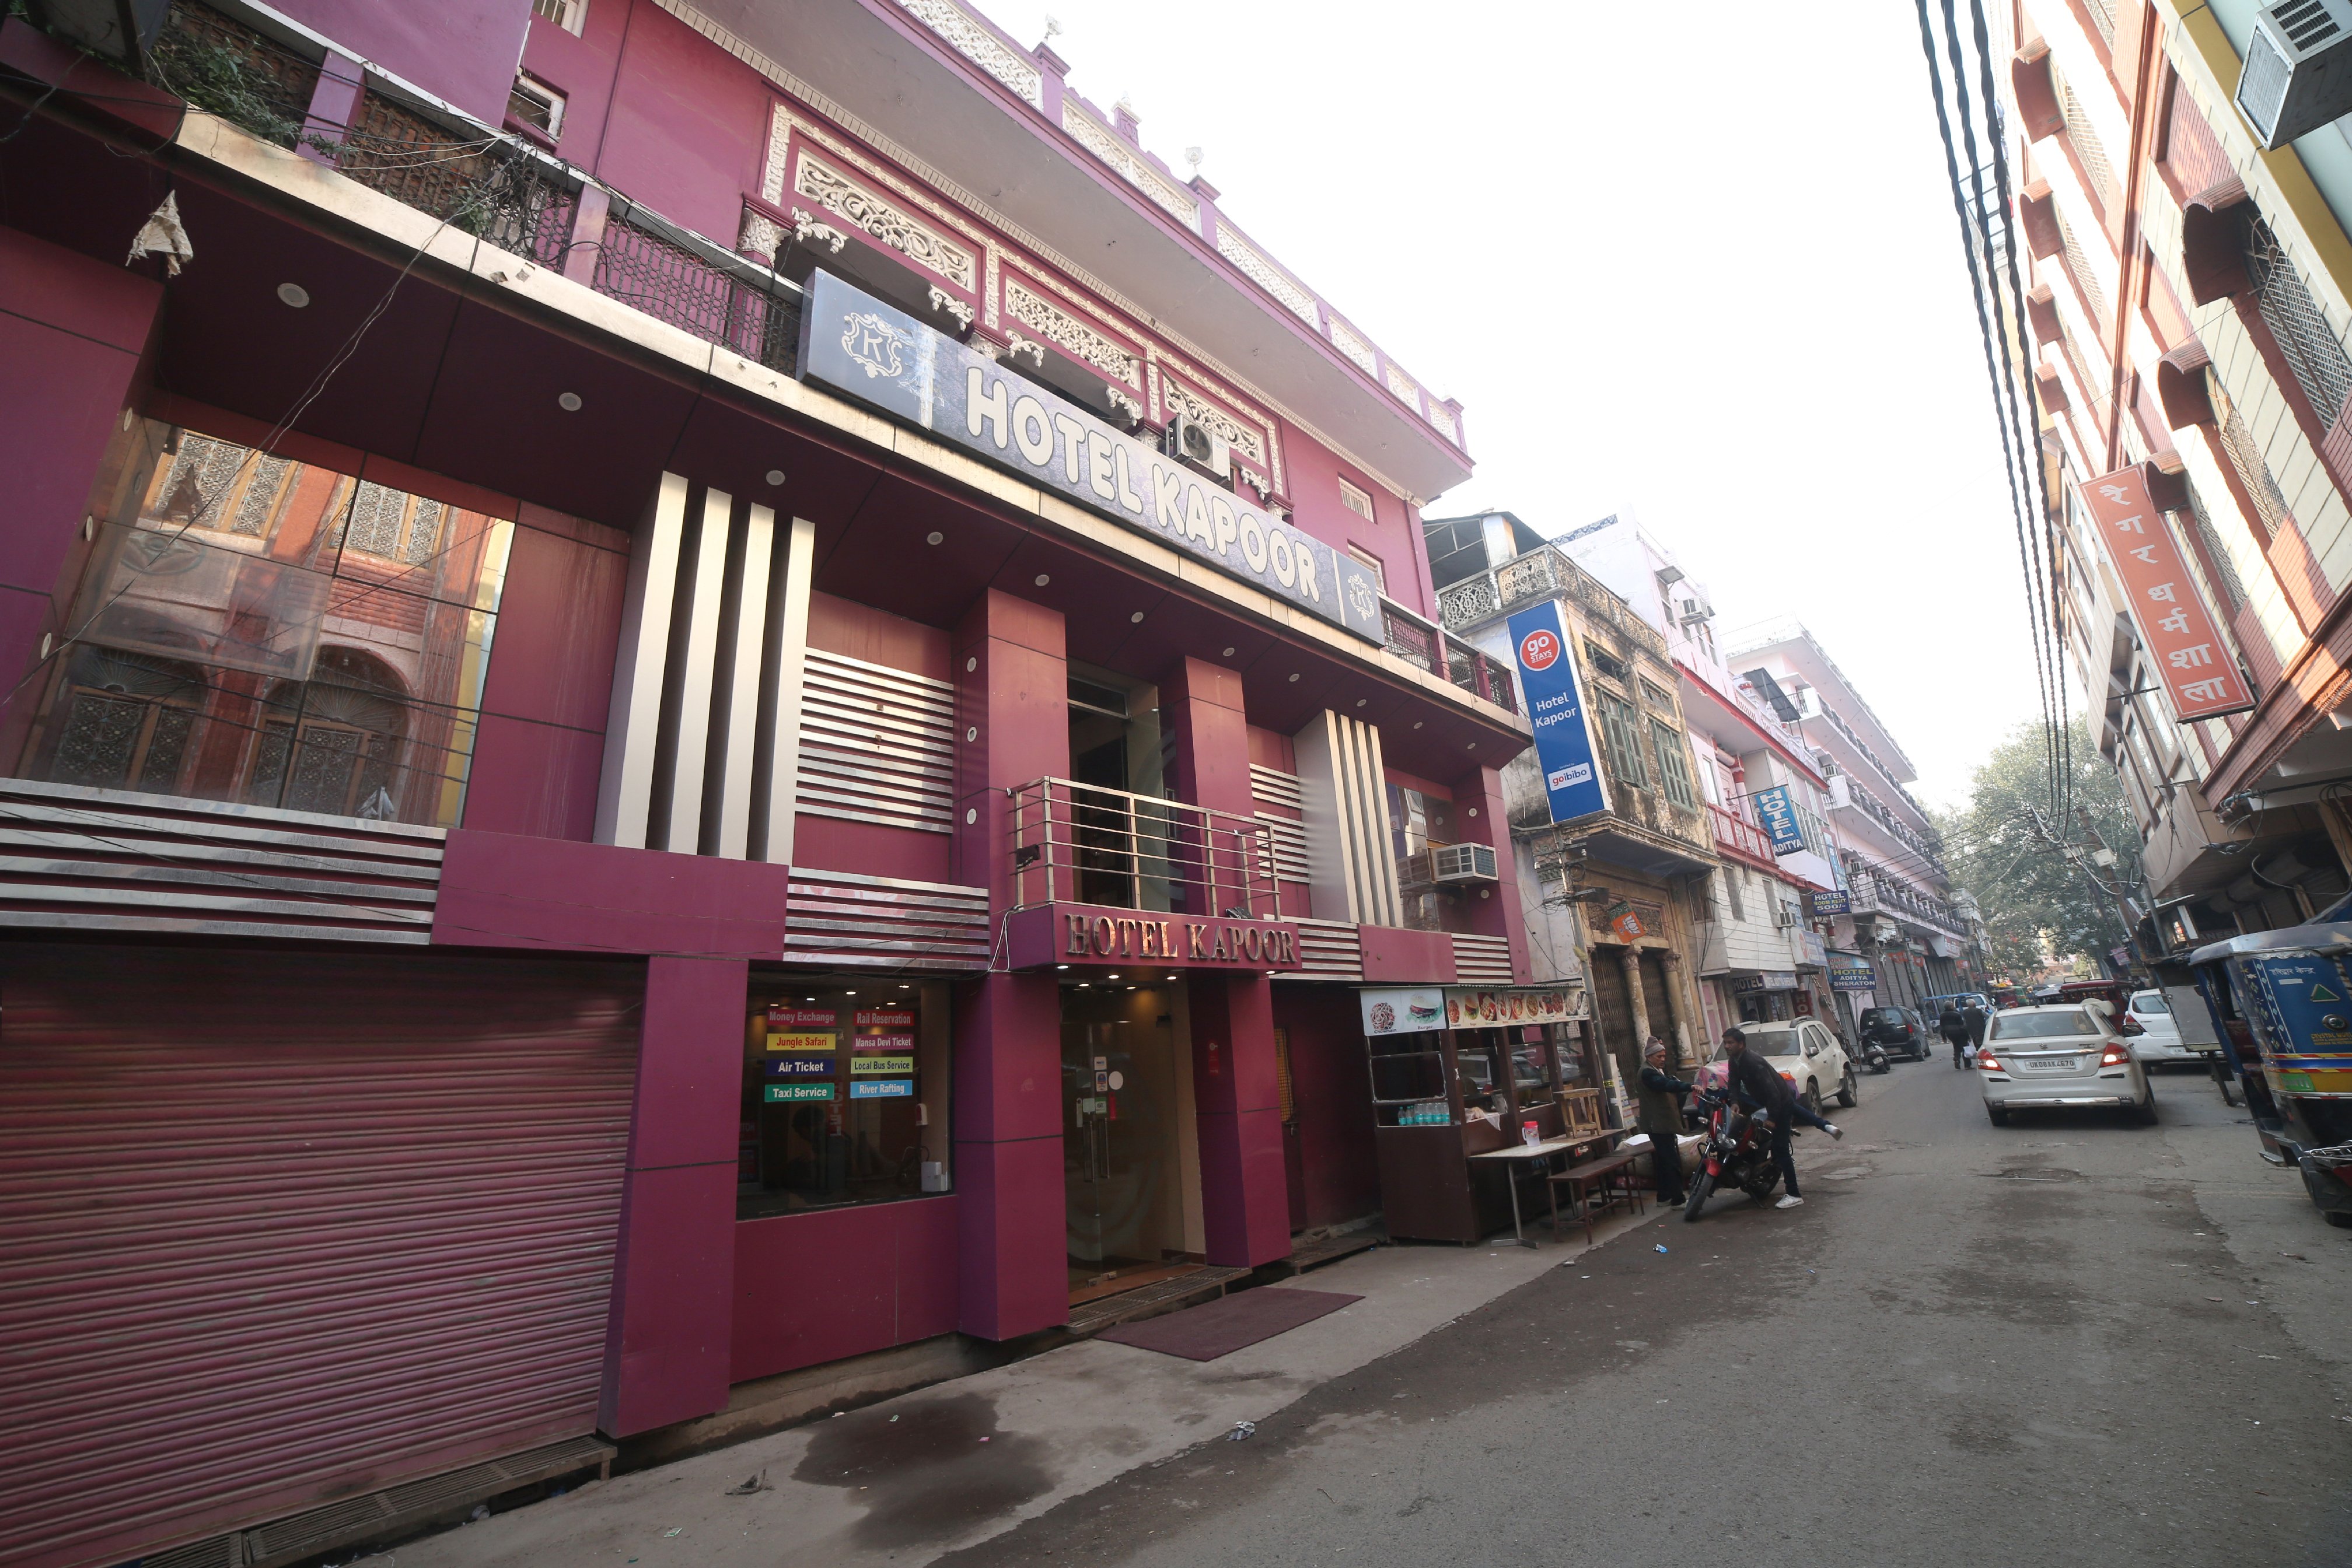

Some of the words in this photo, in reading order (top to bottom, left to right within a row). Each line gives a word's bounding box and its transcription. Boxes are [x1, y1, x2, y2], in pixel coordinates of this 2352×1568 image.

[864, 330, 883, 362] K
[966, 366, 1143, 514] HOTEL
[1154, 463, 1320, 604] KAPOOR
[1527, 635, 1549, 656] go
[1530, 649, 1552, 663] STAYS
[1536, 692, 1570, 712] Hotel
[1535, 707, 1577, 728] Kapoor
[1552, 768, 1587, 786] goibibo
[1759, 789, 1795, 840] HOTEL
[1773, 838, 1803, 854] ADITYA
[1815, 892, 1844, 901] HOTEL
[1065, 914, 1178, 958] HOTEL
[1186, 923, 1298, 963] KAPOOR
[1734, 976, 1763, 991] HOTEL
[770, 1012, 795, 1023] Money
[797, 1011, 835, 1023] Exchange
[857, 1013, 870, 1024] Rail
[872, 1013, 911, 1024] Reservation
[777, 1037, 802, 1048] Jungle
[805, 1037, 827, 1046] Safari
[855, 1038, 876, 1047] Mansa
[878, 1037, 891, 1047] Devi
[892, 1037, 911, 1046] Ticket
[778, 1062, 792, 1072] Air
[795, 1062, 824, 1072] Ticket
[854, 1062, 872, 1070] Local
[873, 1061, 885, 1070] Bus
[887, 1060, 910, 1070] Service
[773, 1088, 792, 1098] Taxi
[794, 1087, 827, 1097] Service
[859, 1084, 878, 1094] River
[879, 1084, 905, 1094] Rafting
